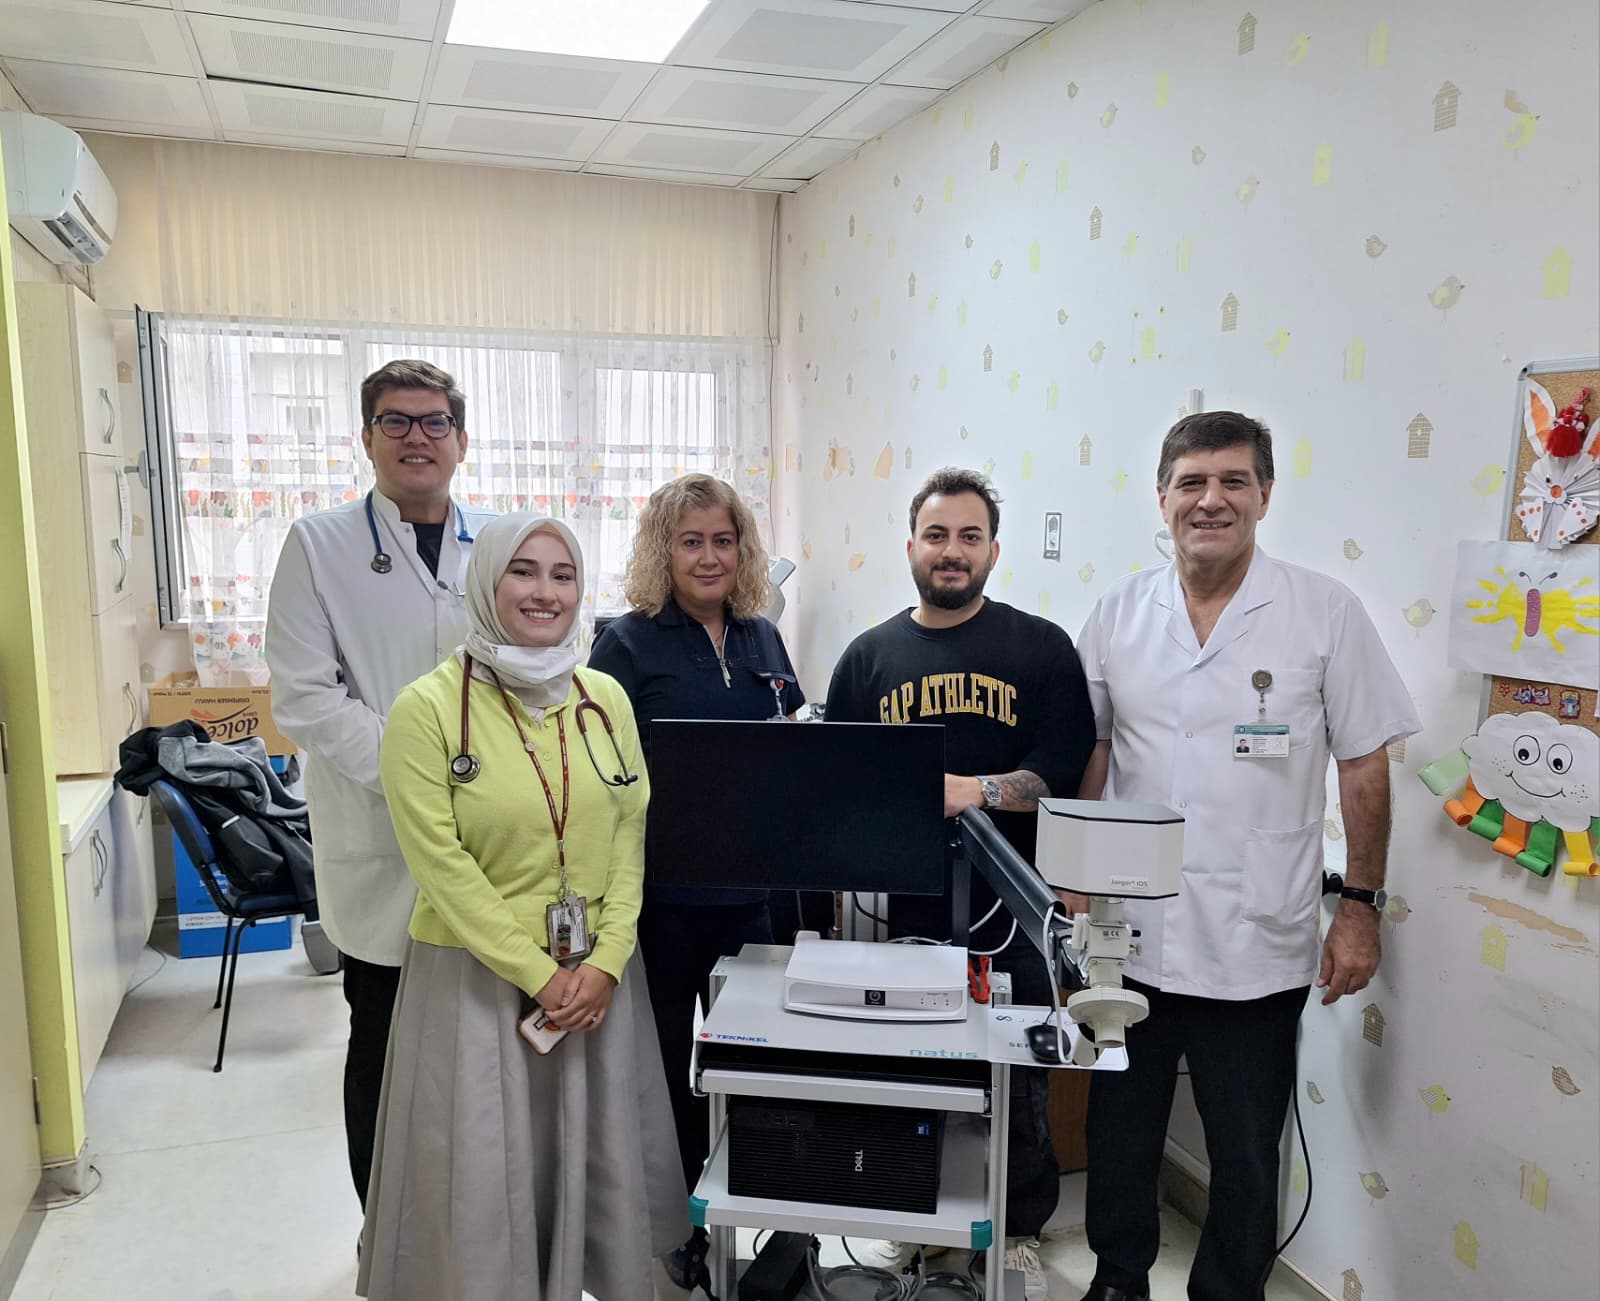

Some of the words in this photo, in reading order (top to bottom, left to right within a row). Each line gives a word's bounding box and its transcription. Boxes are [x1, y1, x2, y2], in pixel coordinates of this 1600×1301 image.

[879, 681, 914, 724] GAP
[919, 672, 1018, 727] ATHLETIC
[207, 716, 259, 739] dolce
[909, 1048, 977, 1059] natus
[854, 1148, 864, 1172] DELL
